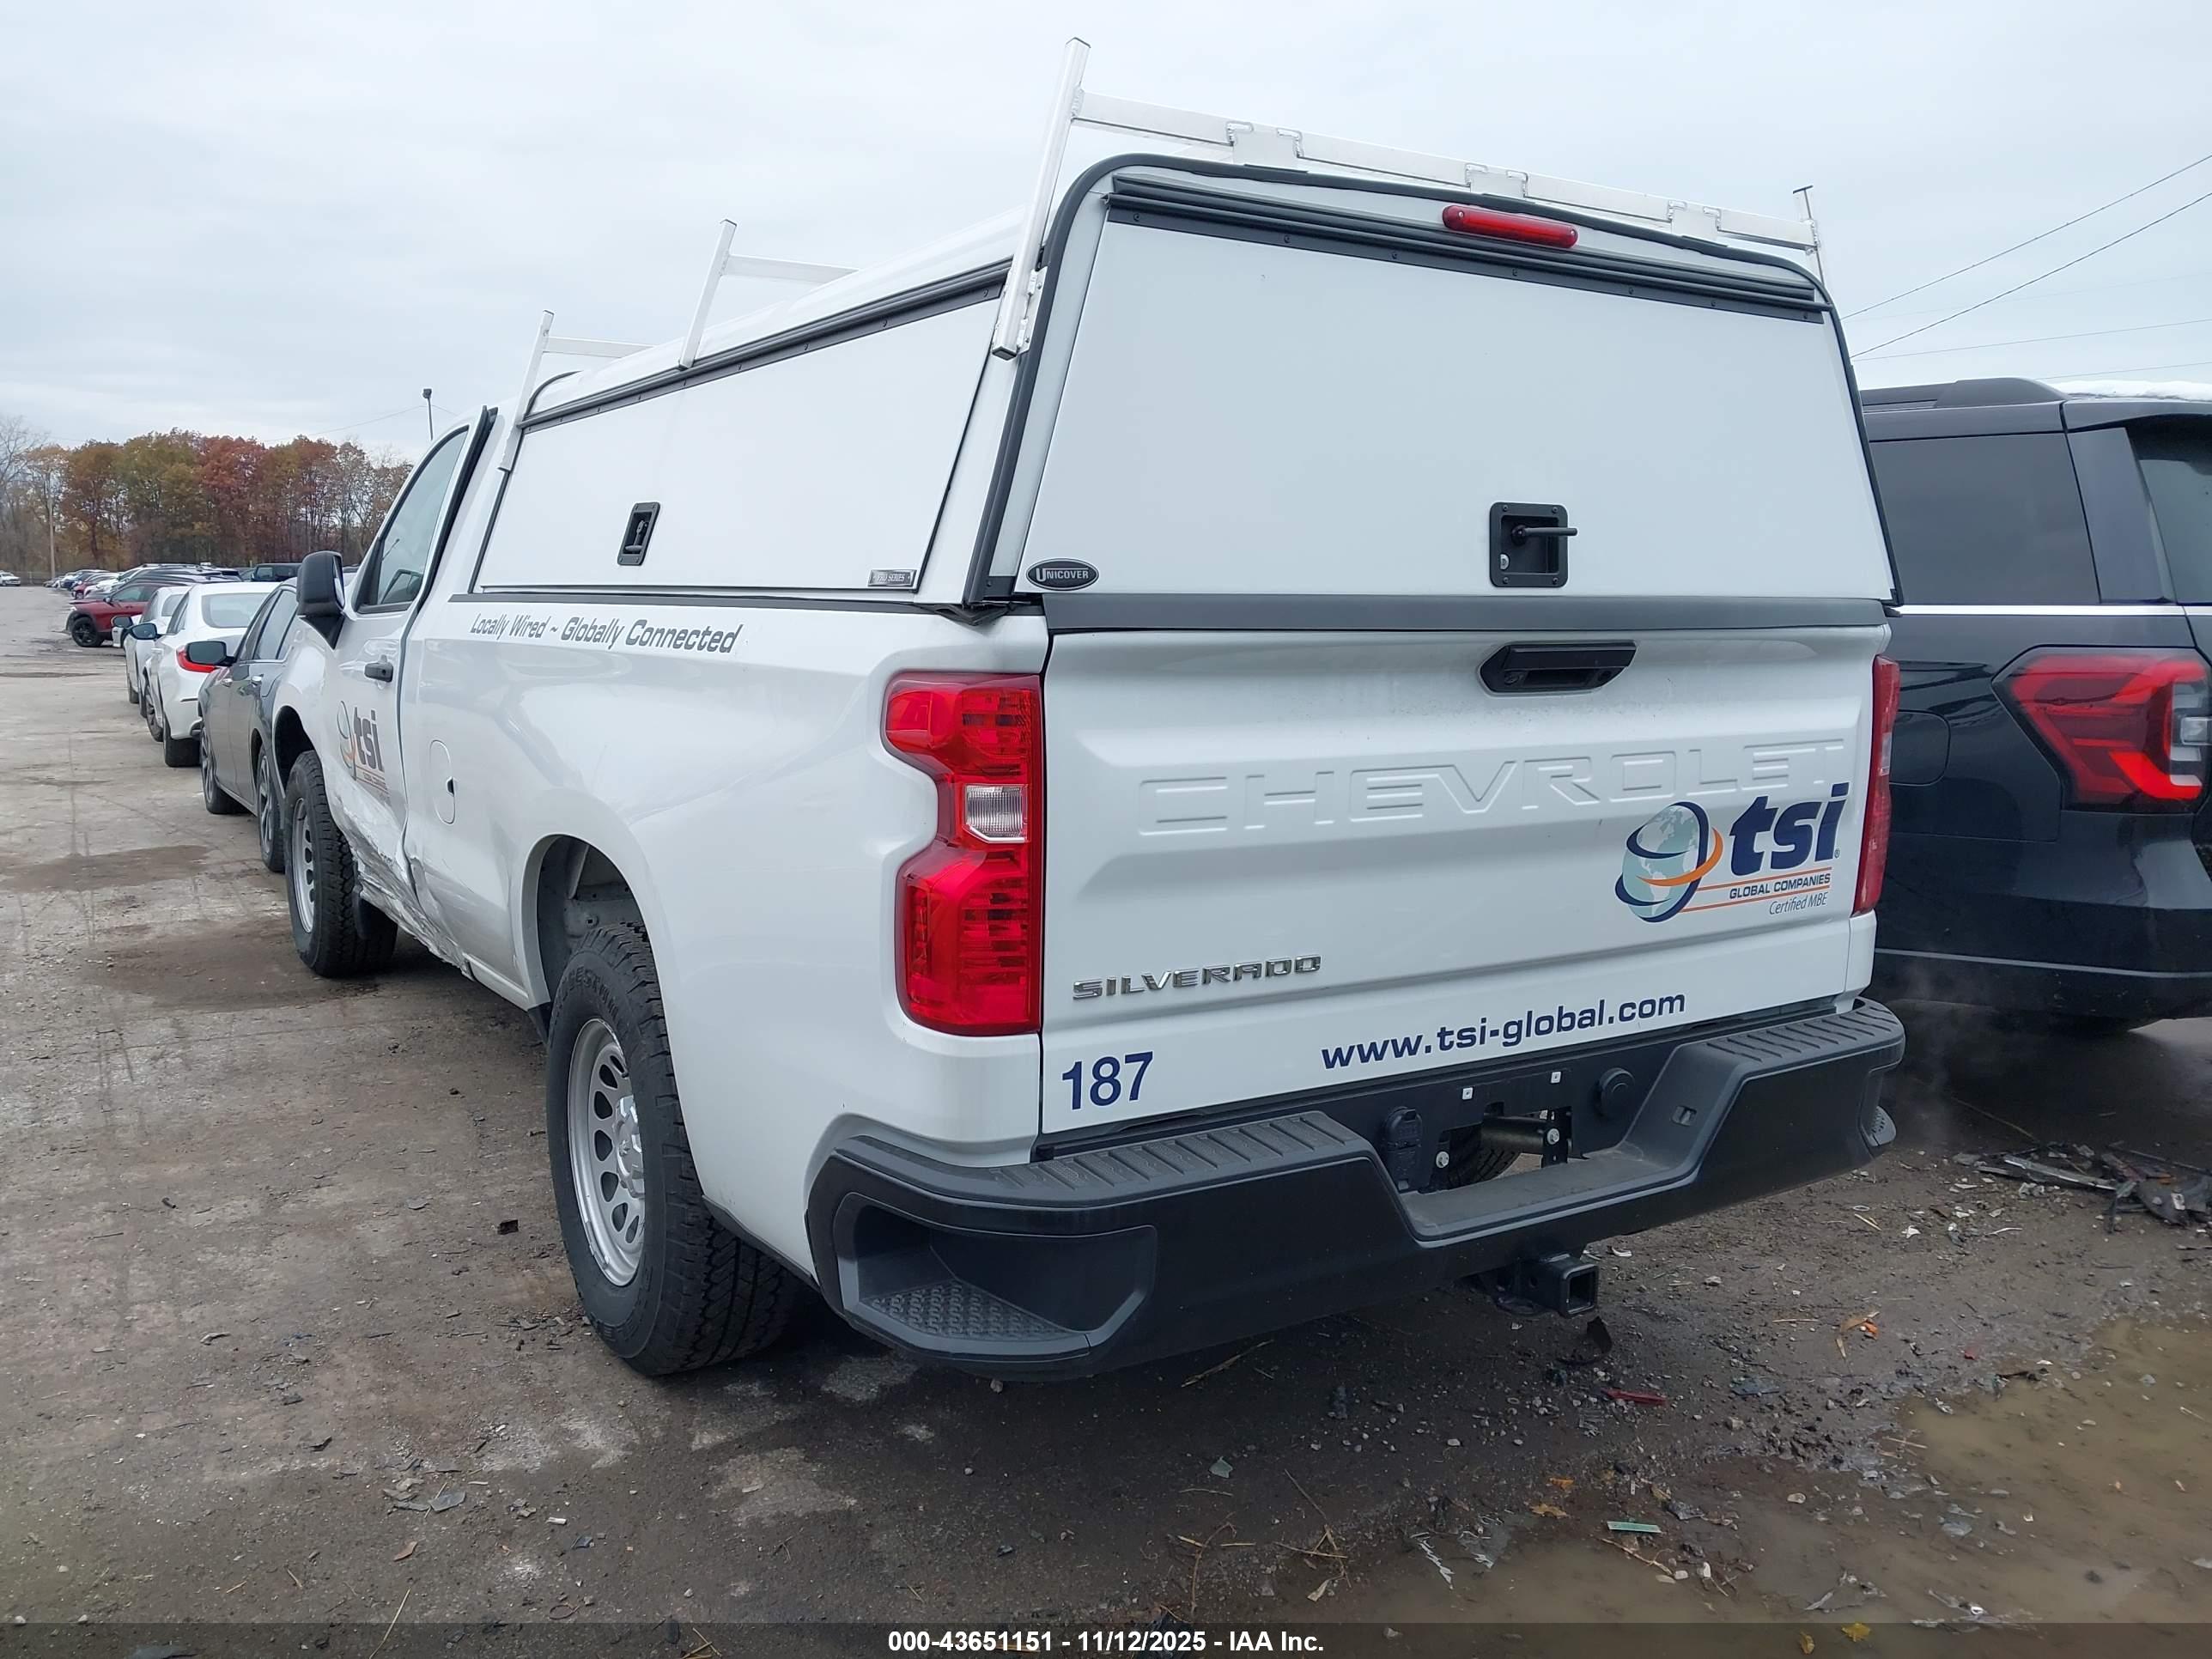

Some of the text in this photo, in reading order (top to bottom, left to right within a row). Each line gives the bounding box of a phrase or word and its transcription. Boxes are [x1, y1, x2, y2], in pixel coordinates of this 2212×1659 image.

[1036, 568, 1089, 582] UNICOVER
[470, 613, 510, 640] Locally
[510, 614, 551, 638] Wired
[561, 617, 627, 649] Globally
[625, 619, 744, 653] Connected
[354, 707, 384, 772] tsi
[1139, 739, 1844, 836] CHEVROLET
[1729, 873, 1831, 899] GLOBAL COMPANIES
[1769, 892, 1829, 915] Certified MBE
[1073, 954, 1322, 1000] SILVERADO
[1322, 994, 1685, 1069] www.tsi-global.com
[1062, 1051, 1153, 1109] 187
